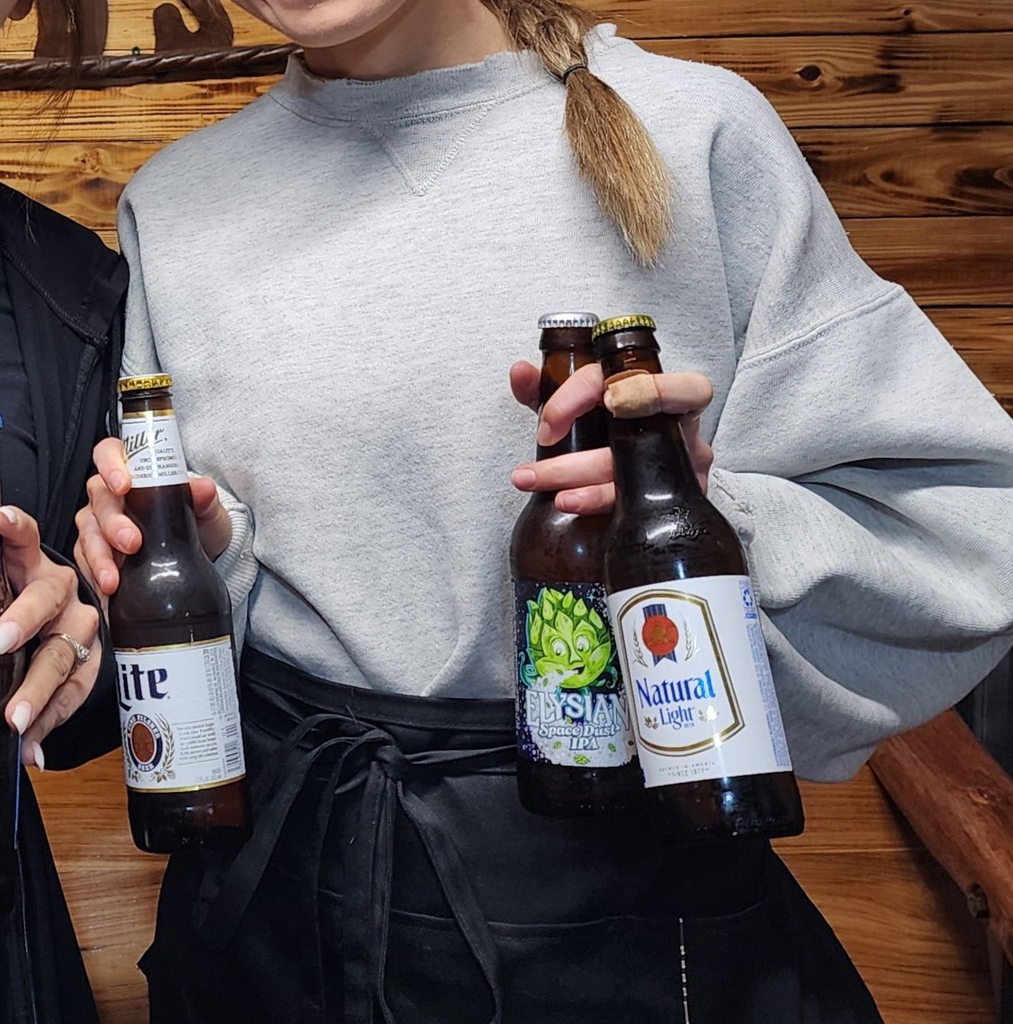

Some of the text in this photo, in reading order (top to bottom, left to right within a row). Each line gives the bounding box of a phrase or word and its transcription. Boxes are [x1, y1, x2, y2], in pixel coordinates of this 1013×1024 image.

[123, 428, 165, 455] illr
[635, 669, 716, 708] Natural
[525, 689, 630, 731] ELYSIAN
[659, 704, 695, 730] Light
[538, 721, 618, 738] Space Dust
[569, 736, 599, 750] IPA
